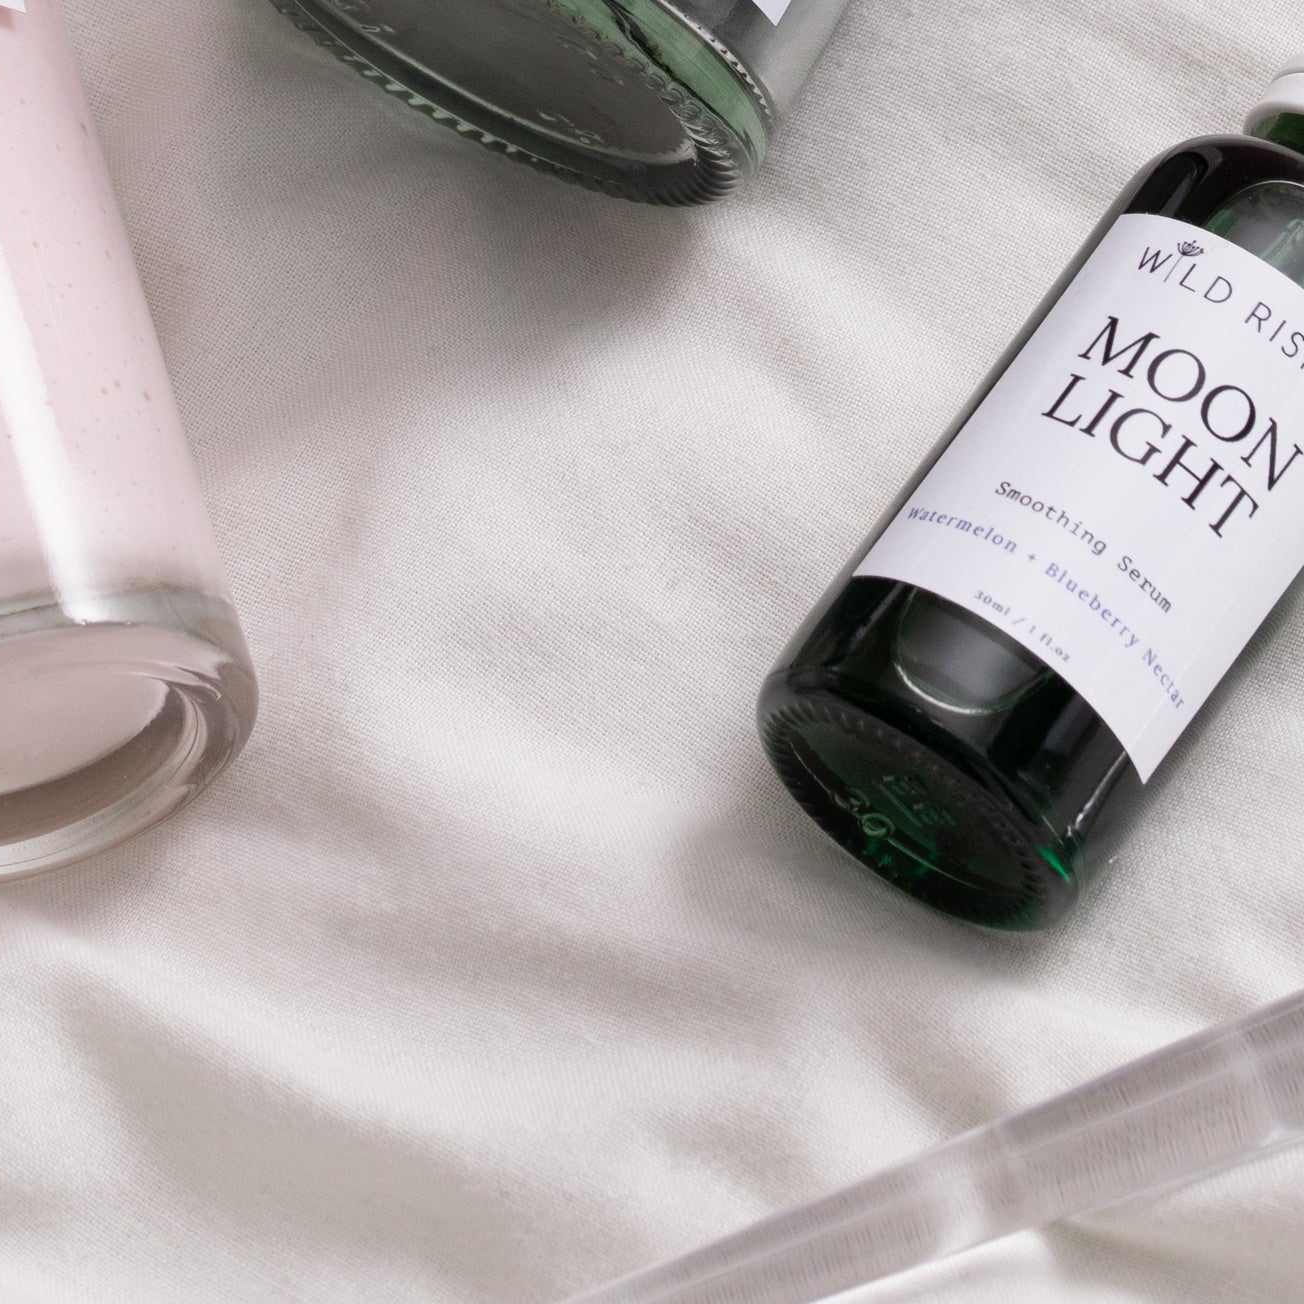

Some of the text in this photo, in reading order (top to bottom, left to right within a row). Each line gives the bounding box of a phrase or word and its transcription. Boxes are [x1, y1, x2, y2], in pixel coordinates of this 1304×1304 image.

[1138, 240, 1233, 304] WILD
[1041, 374, 1259, 539] LIGHT
[1077, 316, 1304, 491] MOON
[906, 506, 1017, 554] Watermelon
[1044, 562, 1139, 650] Blueberry
[1142, 647, 1185, 710] Nectar
[974, 590, 1009, 616] 30ml
[995, 481, 1173, 614] Smoothing Serum
